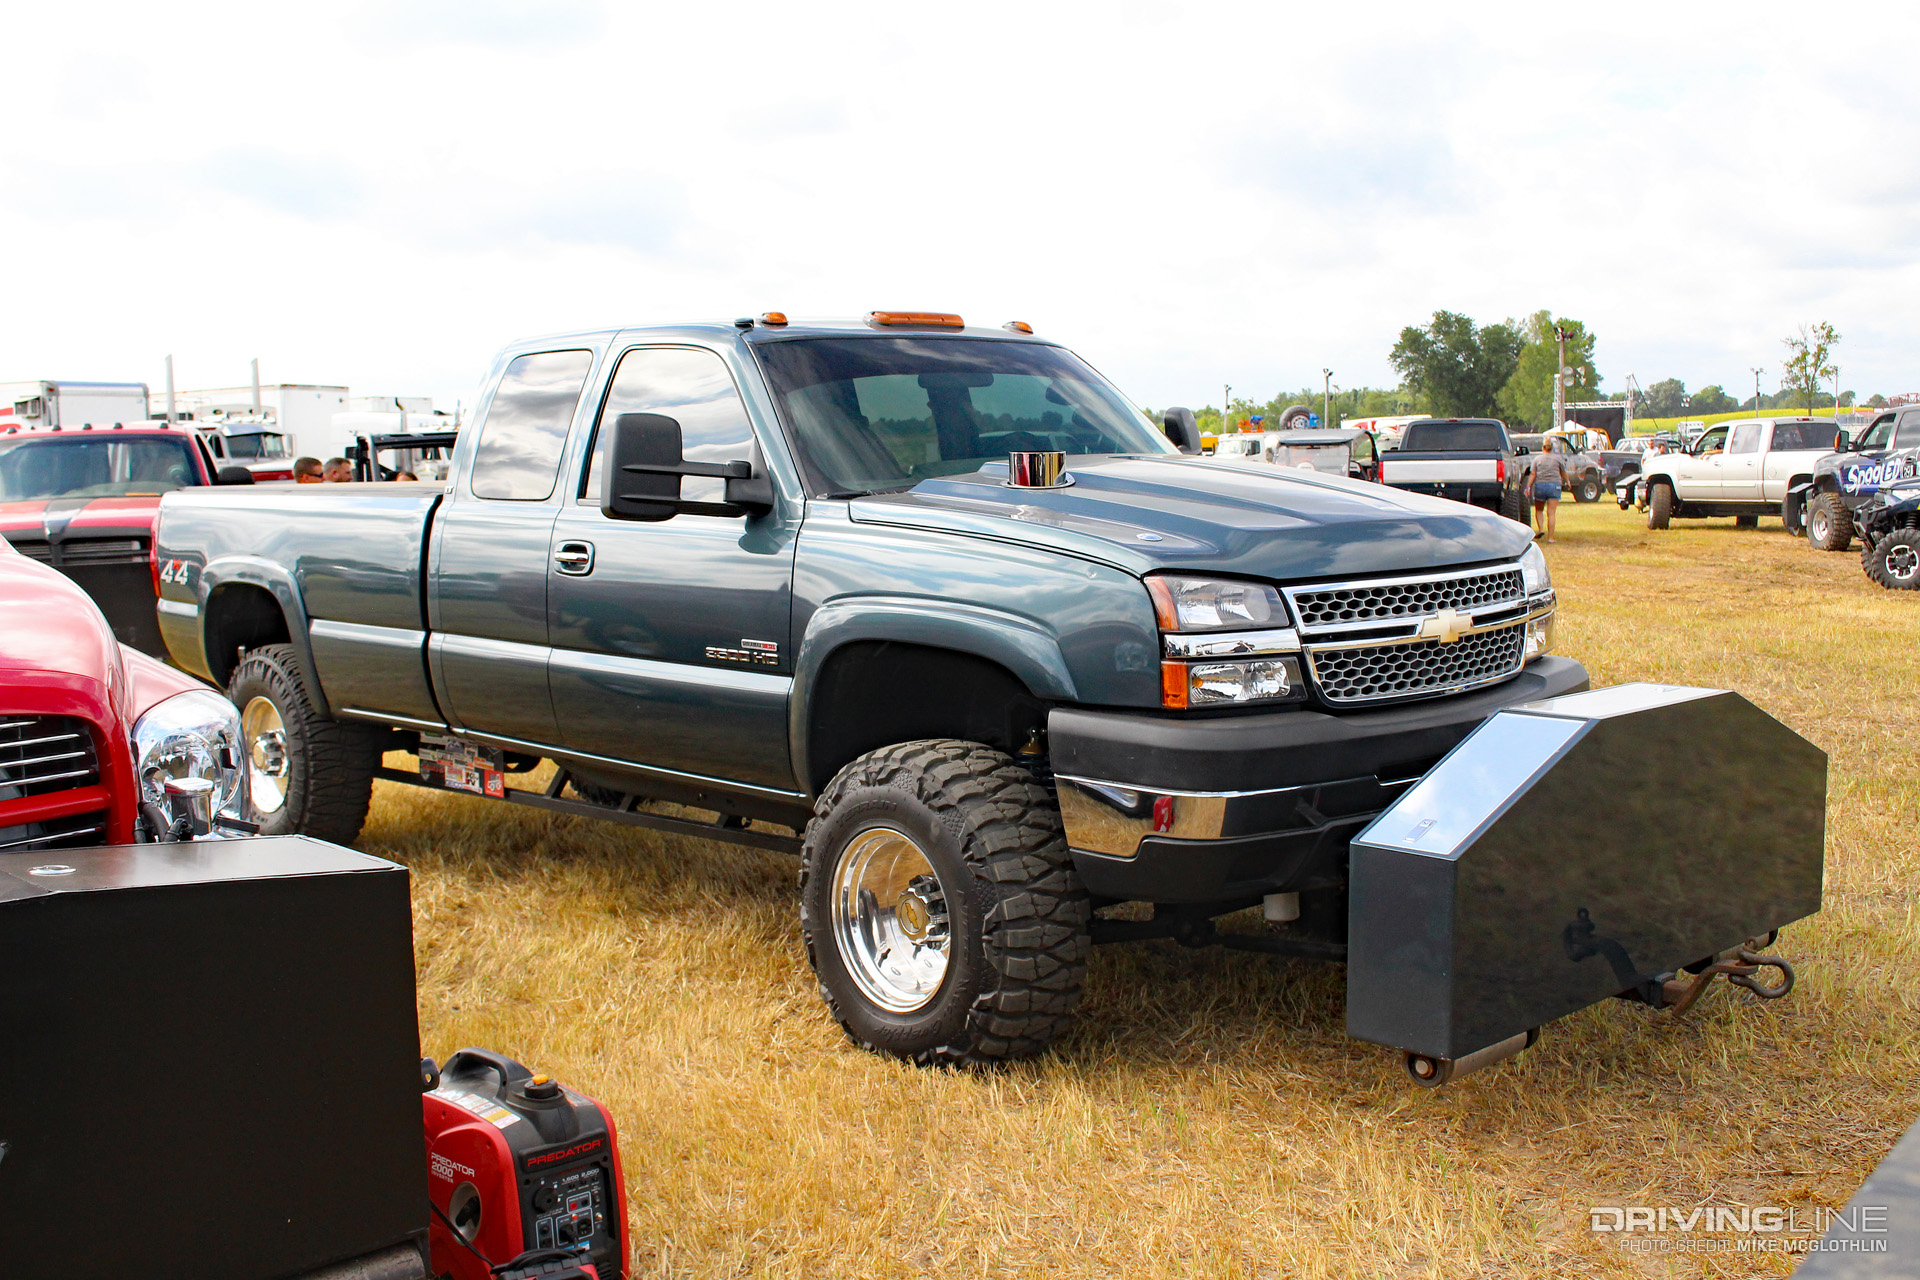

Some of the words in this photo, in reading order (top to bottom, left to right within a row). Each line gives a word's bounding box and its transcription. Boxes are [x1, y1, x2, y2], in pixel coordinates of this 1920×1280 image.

[431, 1151, 475, 1178] PREDATOR
[527, 1138, 605, 1167] PREDATOR
[431, 1161, 454, 1178] 2000
